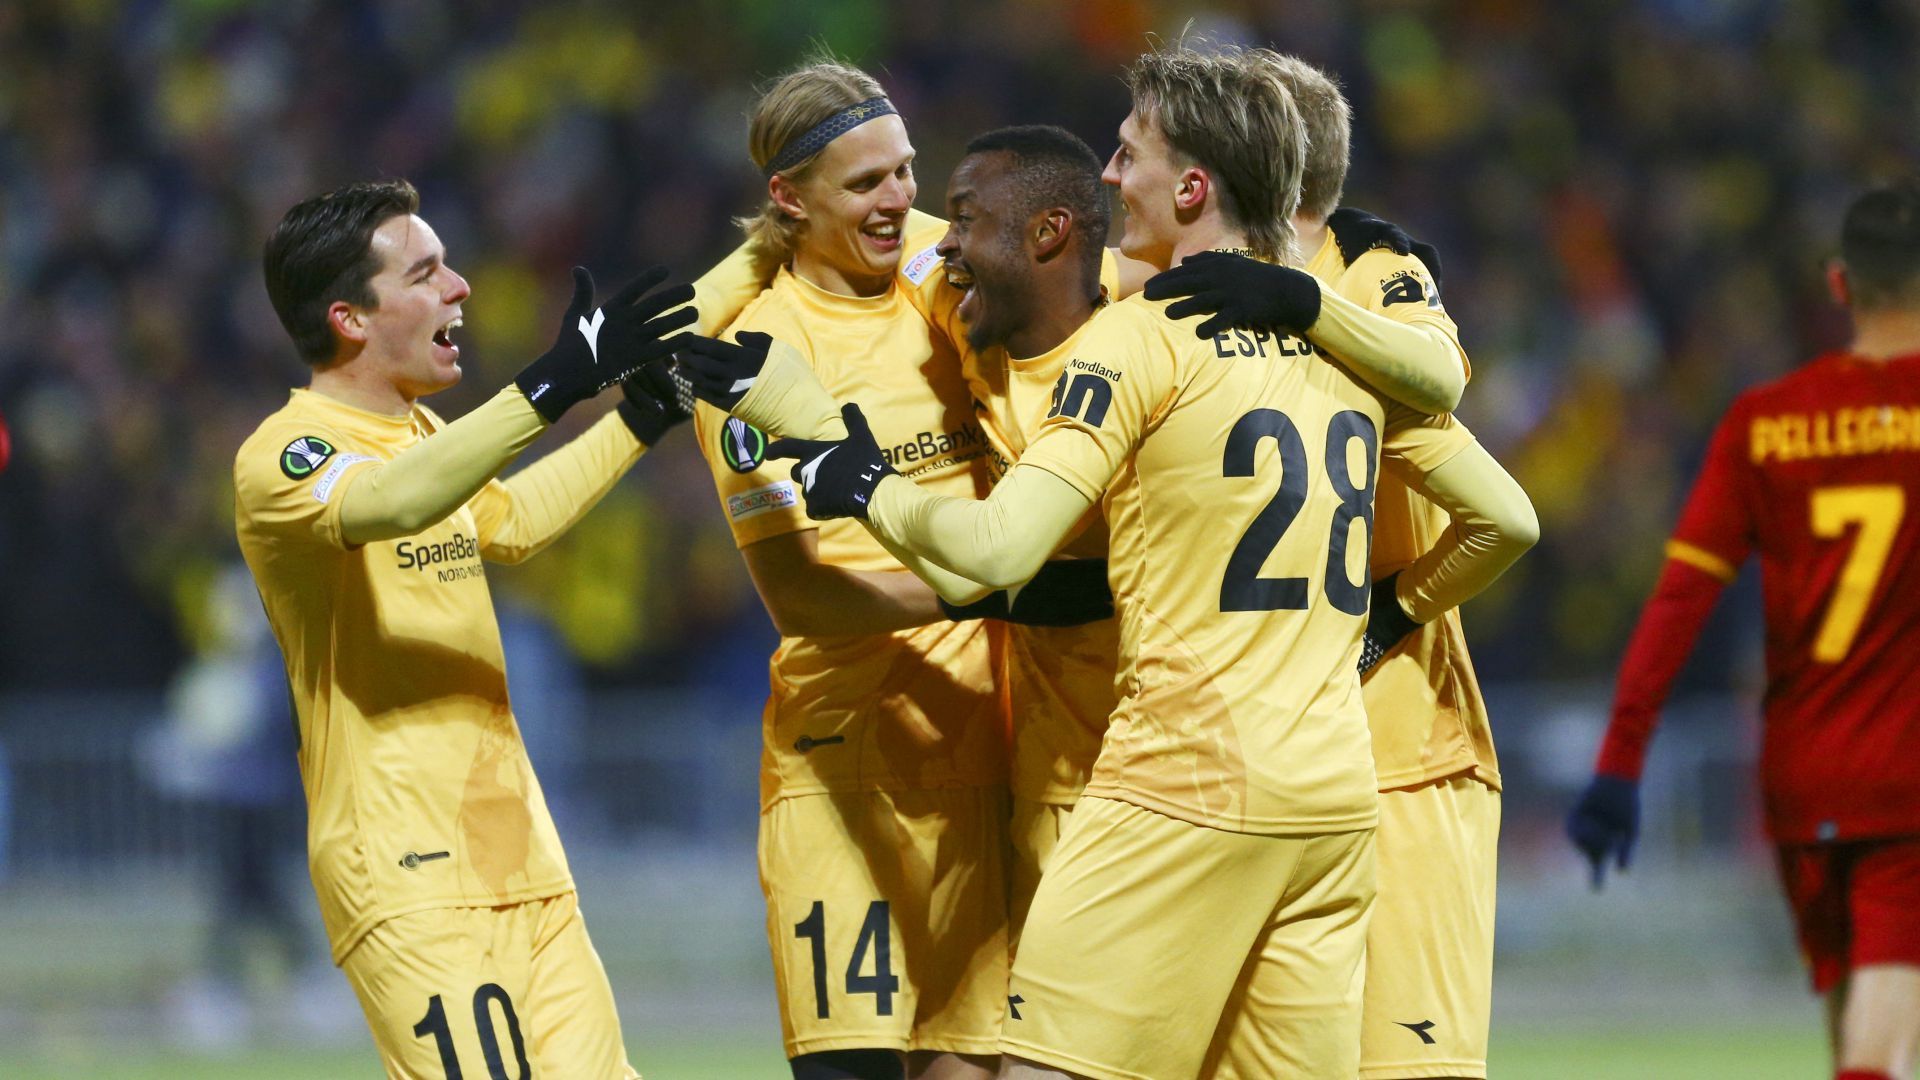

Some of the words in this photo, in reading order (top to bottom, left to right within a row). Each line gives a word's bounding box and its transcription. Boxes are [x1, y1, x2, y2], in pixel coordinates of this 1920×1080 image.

[1070, 359, 1122, 382] Nordland
[880, 422, 978, 466] areBank
[396, 533, 479, 571] SpareBan
[1220, 408, 1377, 616] 28
[1812, 484, 1905, 663] 7
[795, 900, 899, 1019] 14
[413, 983, 531, 1080] 10
